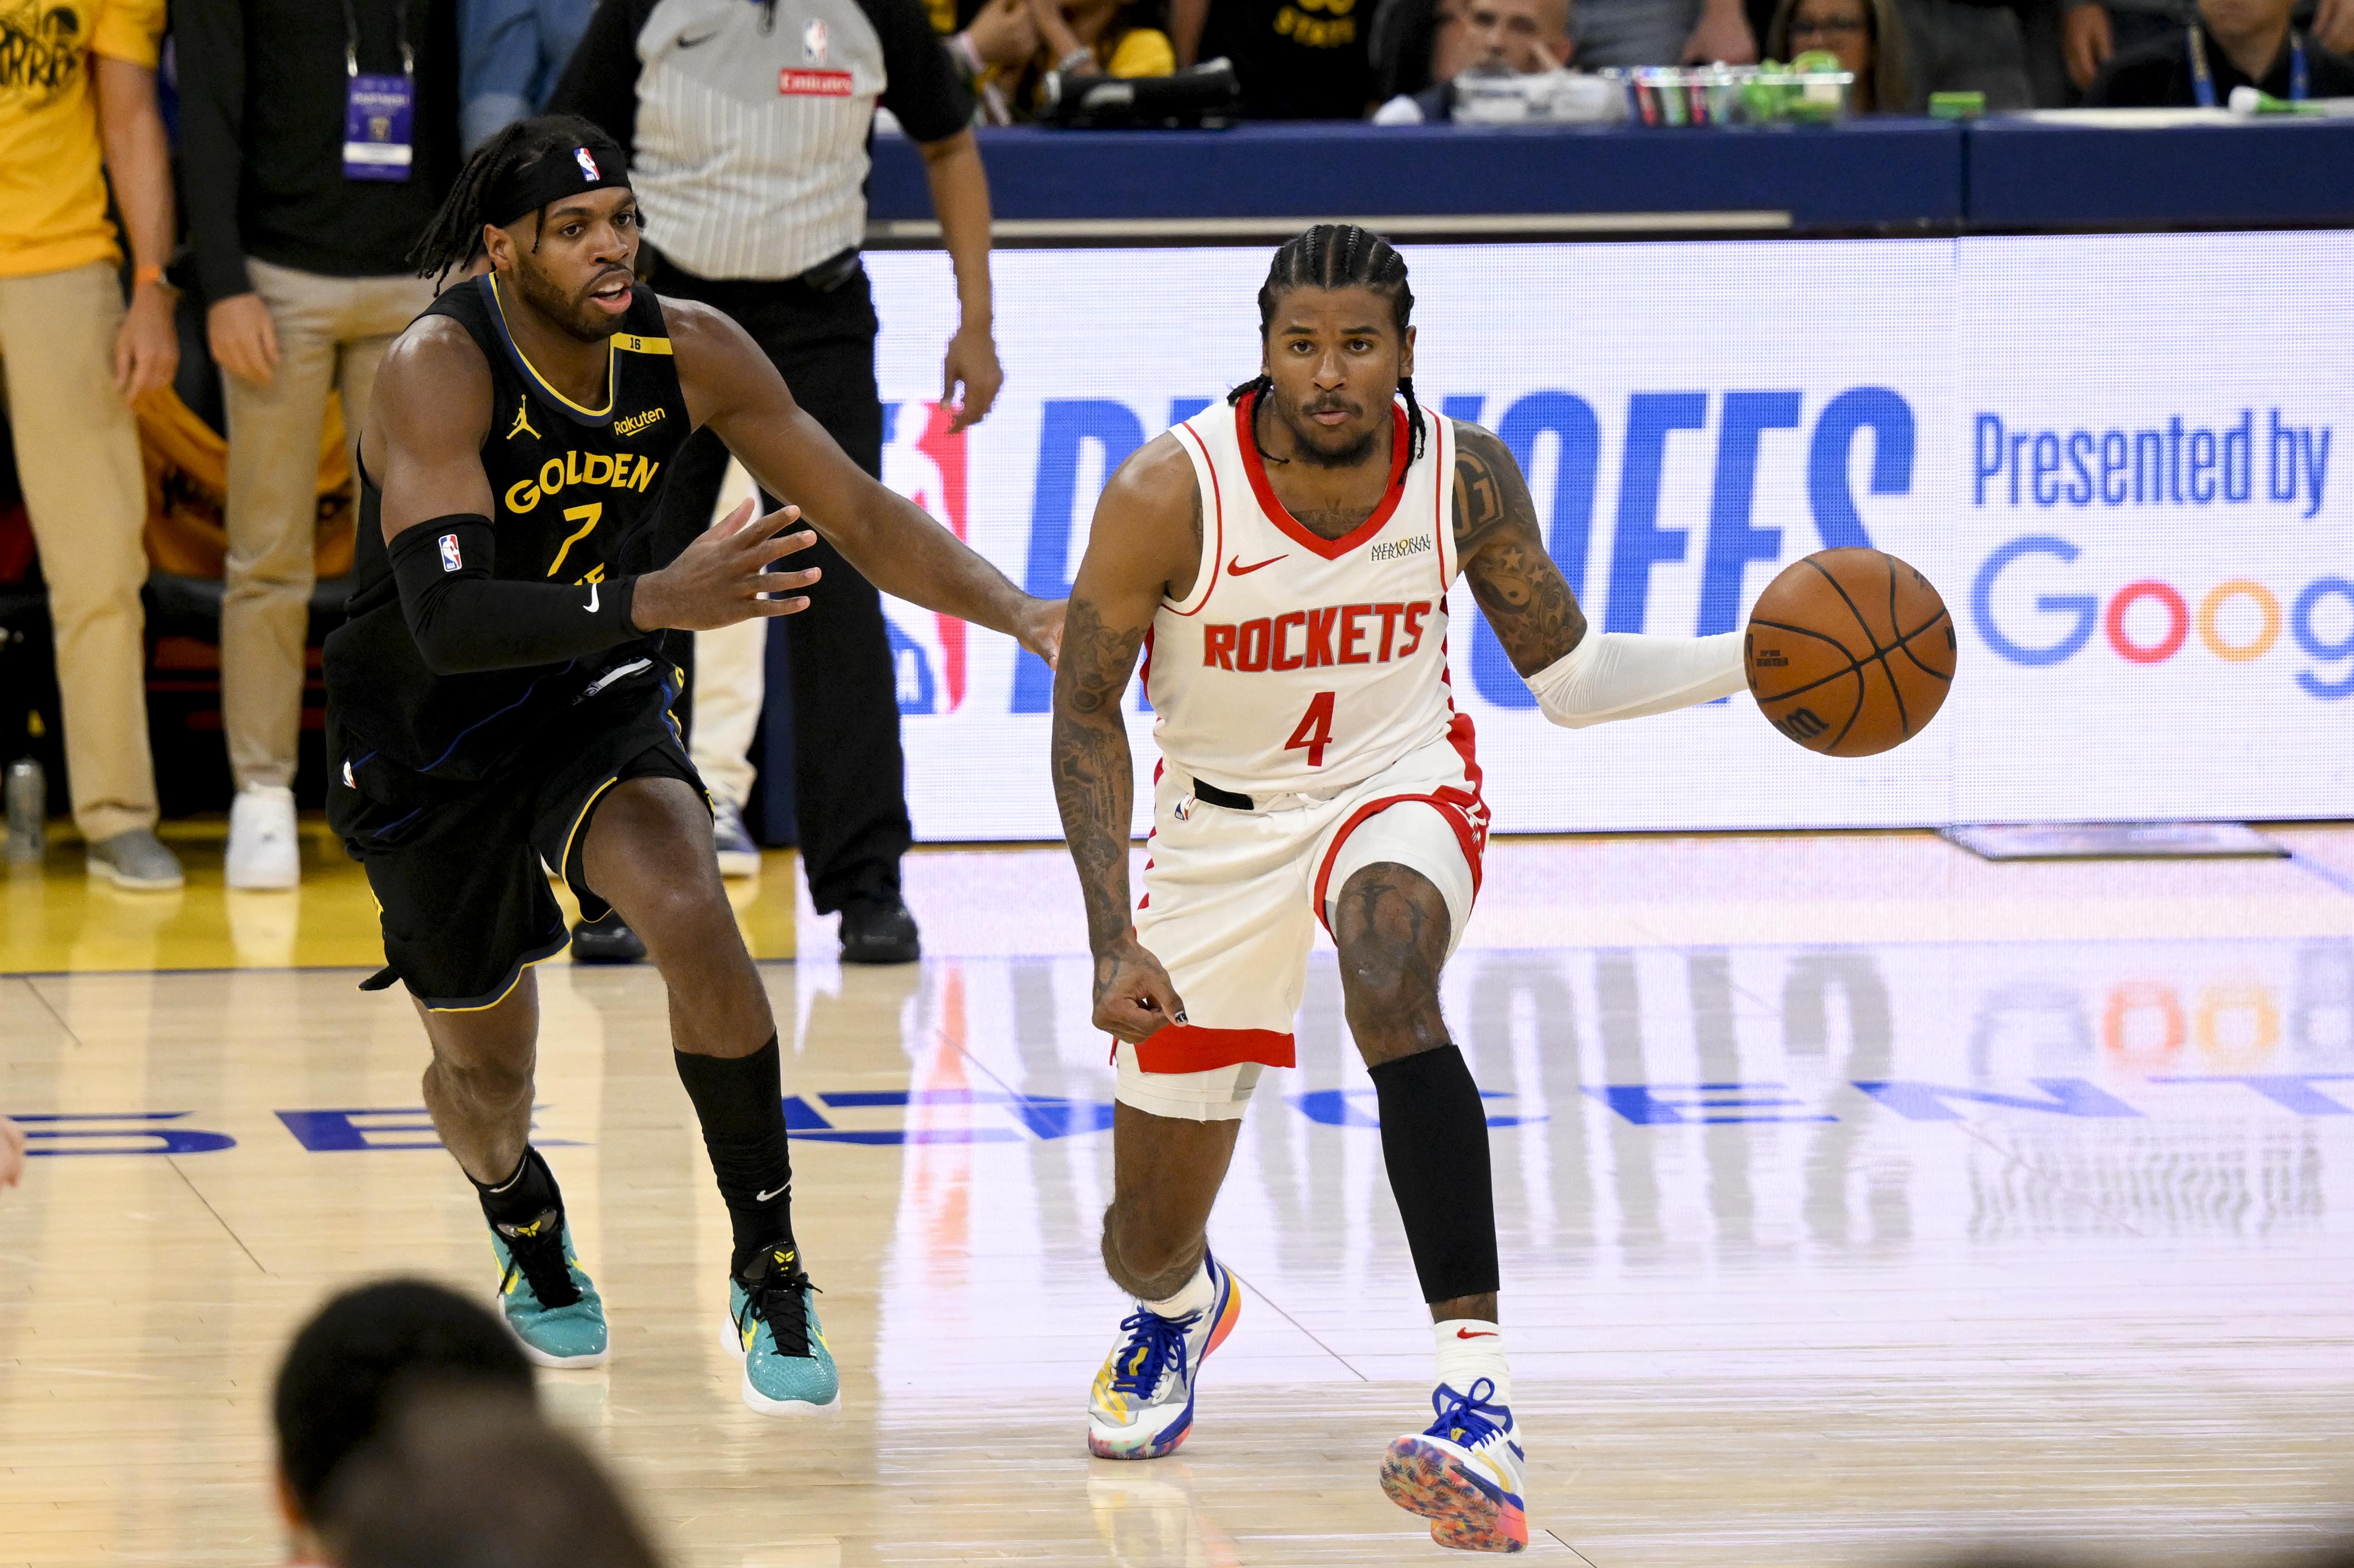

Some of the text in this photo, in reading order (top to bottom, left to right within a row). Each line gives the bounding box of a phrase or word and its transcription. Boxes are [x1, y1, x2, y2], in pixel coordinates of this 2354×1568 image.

[630, 337, 641, 350] 16
[613, 407, 666, 436] Rakuten
[505, 450, 660, 514] GOLDEN
[1973, 407, 2332, 518] Presented by
[547, 502, 602, 577] 7
[1371, 533, 1431, 553] MEMORIAL
[1371, 542, 1431, 561] HERMANN
[1203, 601, 1432, 673] ROCKETS
[1284, 691, 1335, 767] 4
